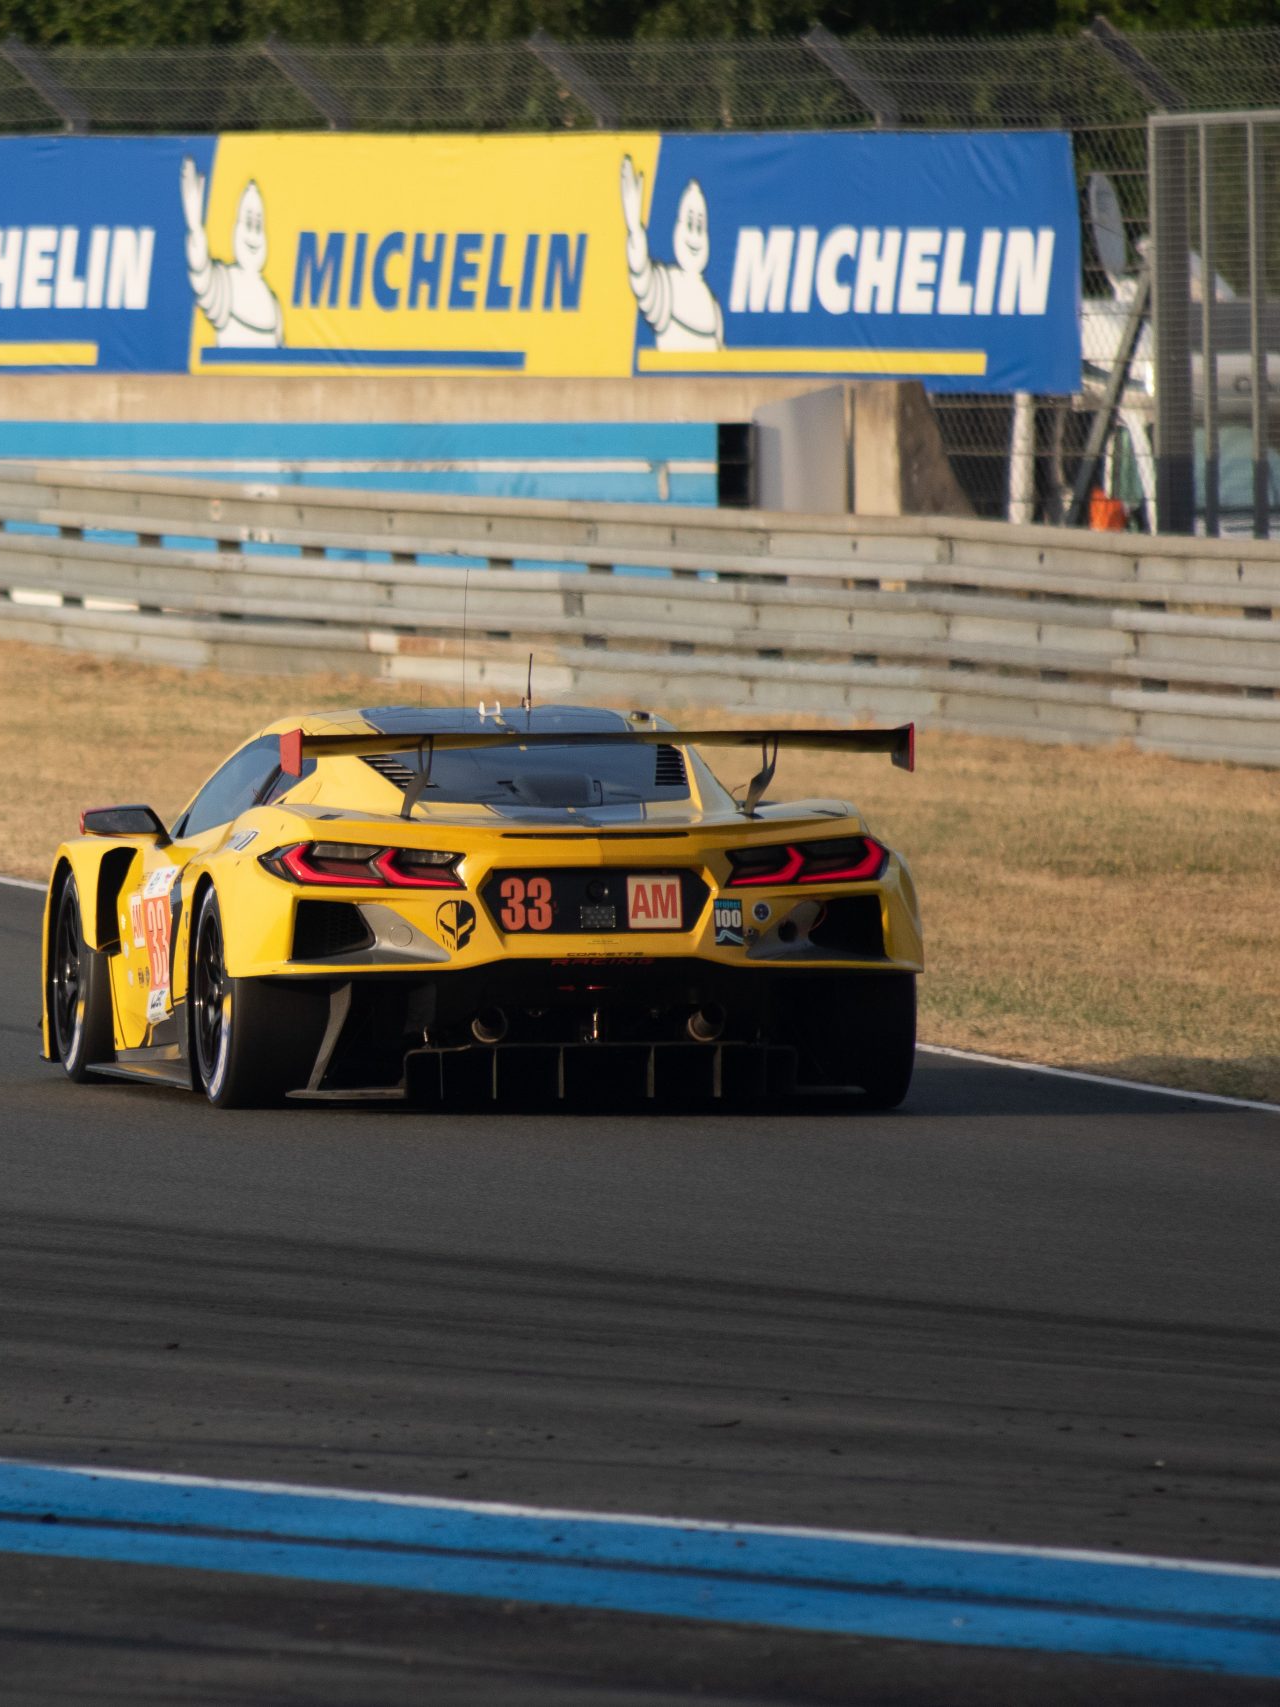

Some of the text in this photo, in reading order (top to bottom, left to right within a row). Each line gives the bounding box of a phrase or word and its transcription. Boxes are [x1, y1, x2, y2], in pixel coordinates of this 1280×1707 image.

[291, 231, 588, 312] MICHELIN
[730, 225, 1055, 316] MICHELIN
[500, 877, 552, 930] 33
[631, 884, 678, 919] AM
[715, 909, 742, 928] 100
[148, 900, 170, 985] 33
